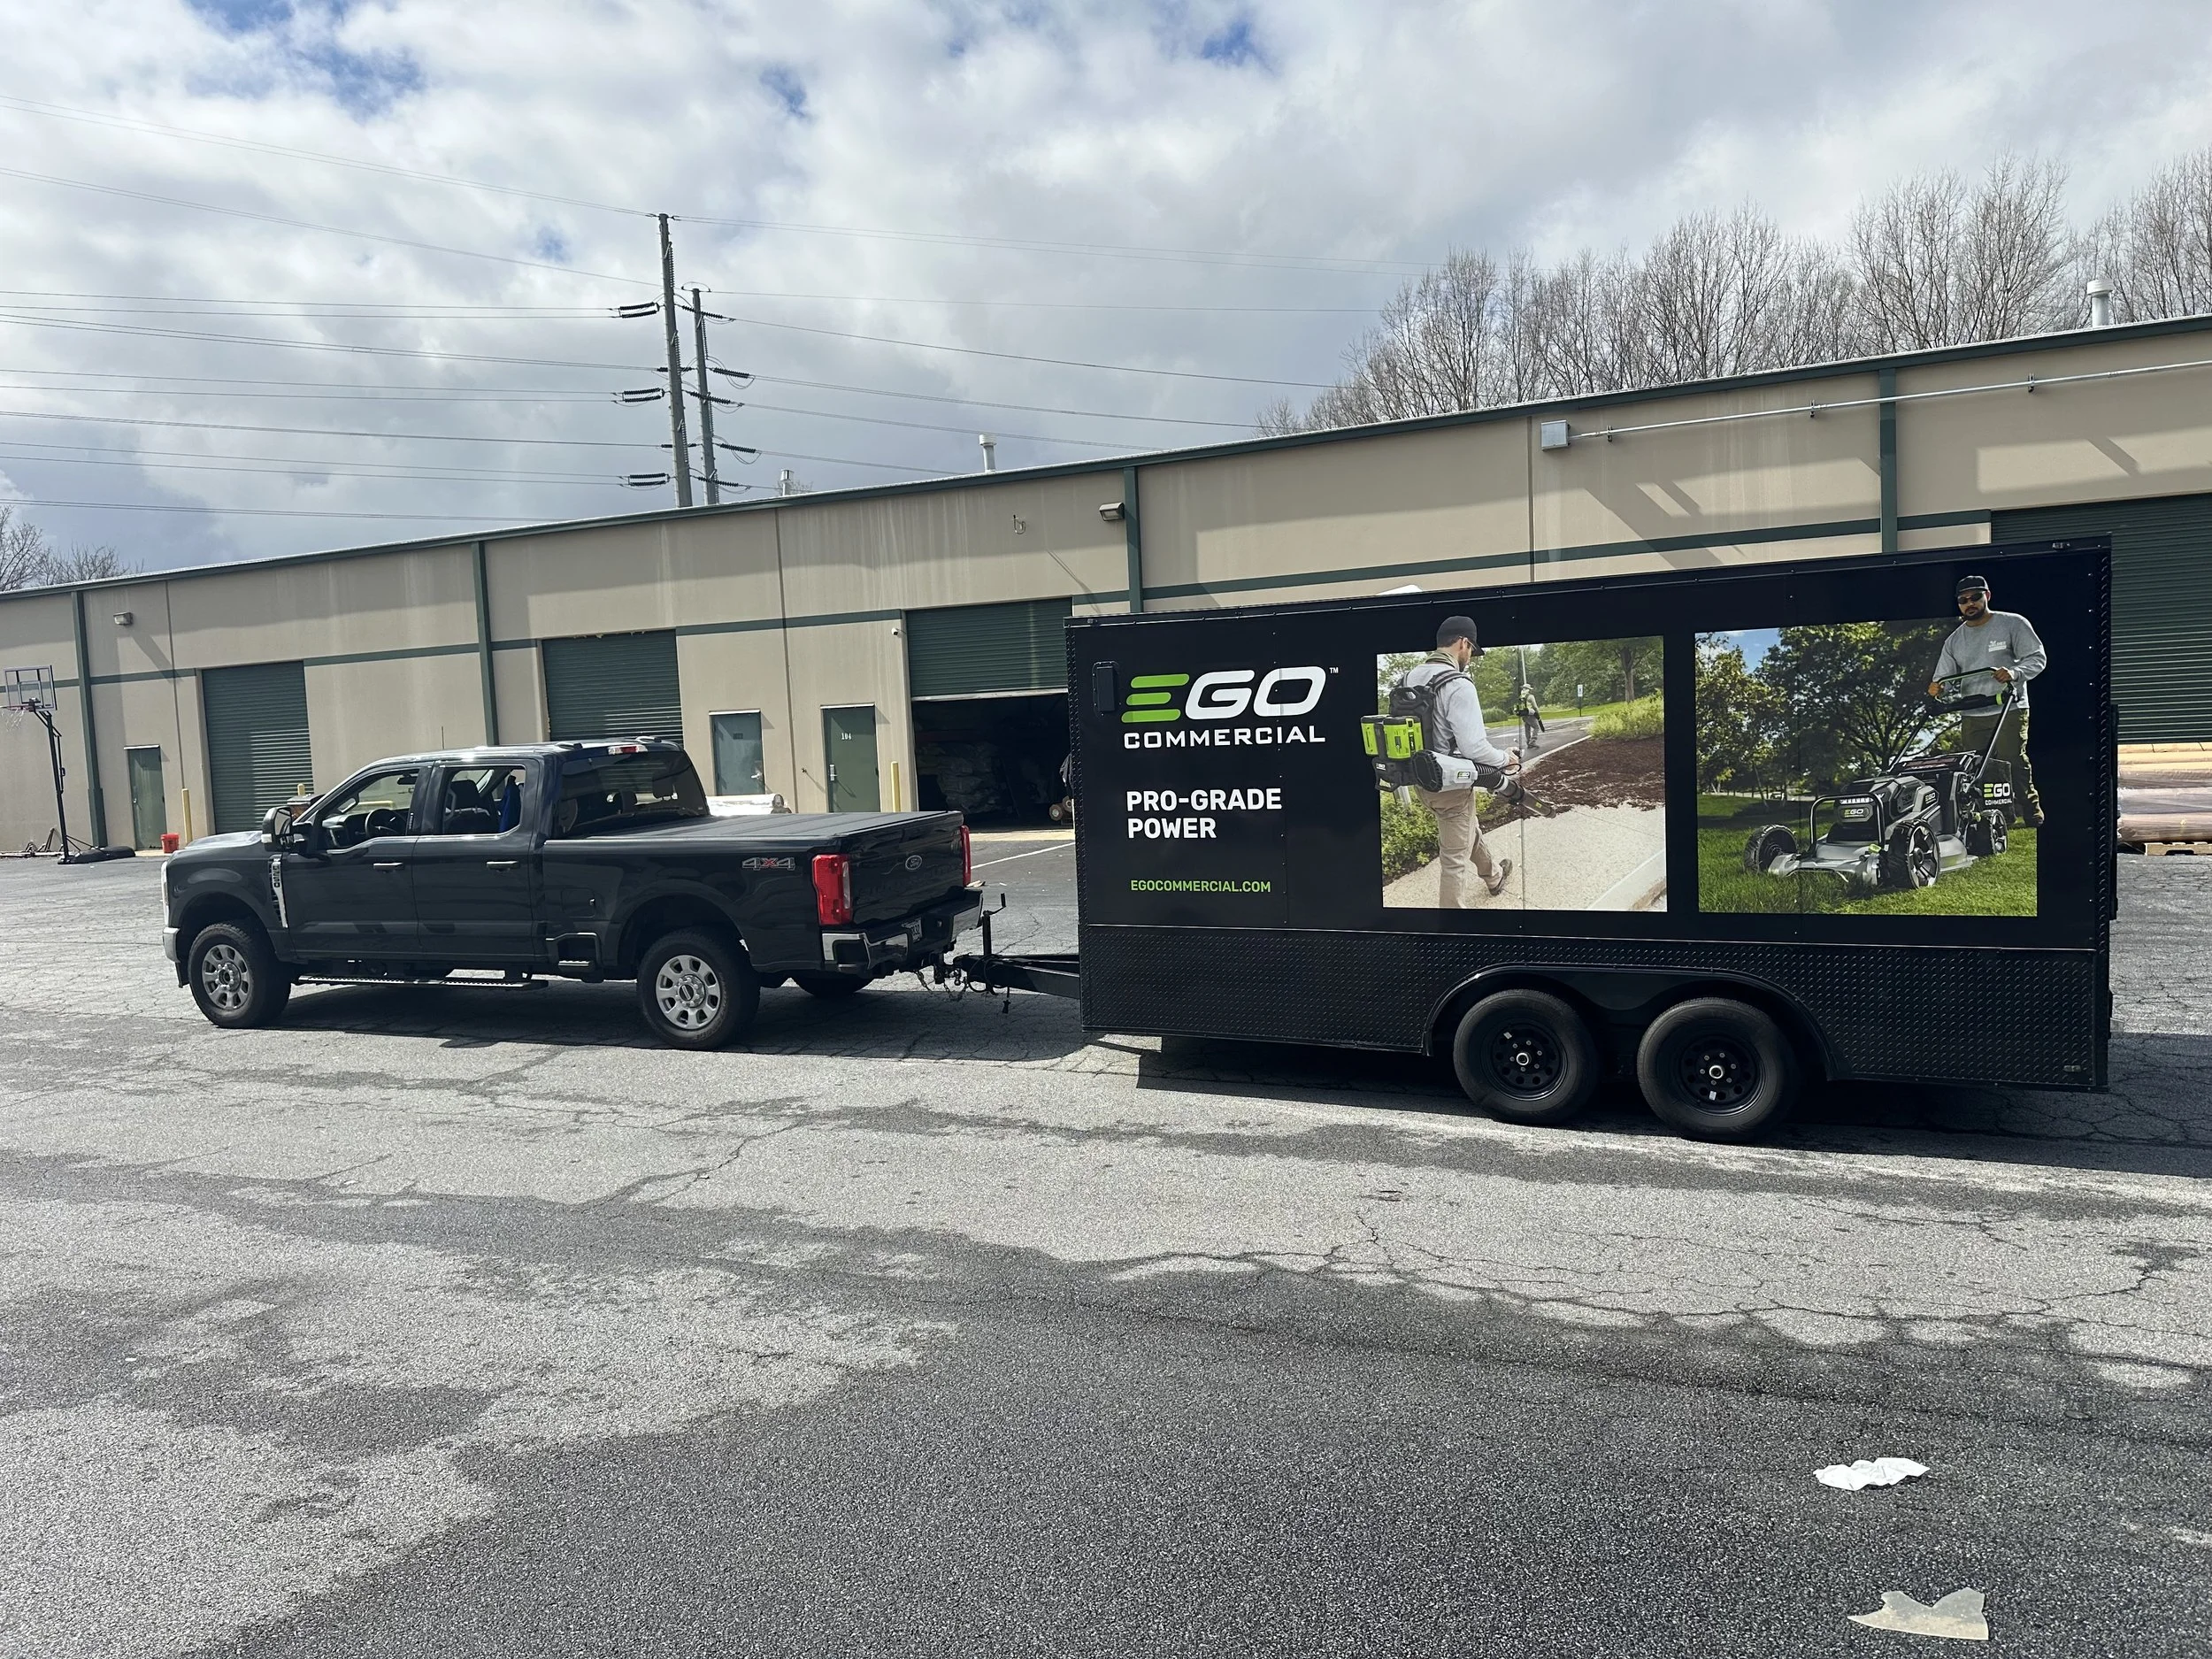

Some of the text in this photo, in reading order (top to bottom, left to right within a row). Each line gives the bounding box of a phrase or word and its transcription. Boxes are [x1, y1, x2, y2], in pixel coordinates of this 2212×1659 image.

[1121, 666, 1326, 723] EGO
[1124, 726, 1325, 749] COMMERCIAL
[1126, 788, 1281, 811] PRO-GRADE
[1984, 783, 2010, 797] EGO
[1127, 817, 1217, 839] POWER
[1131, 879, 1271, 893] EGOCOMMERCIAL.COM
